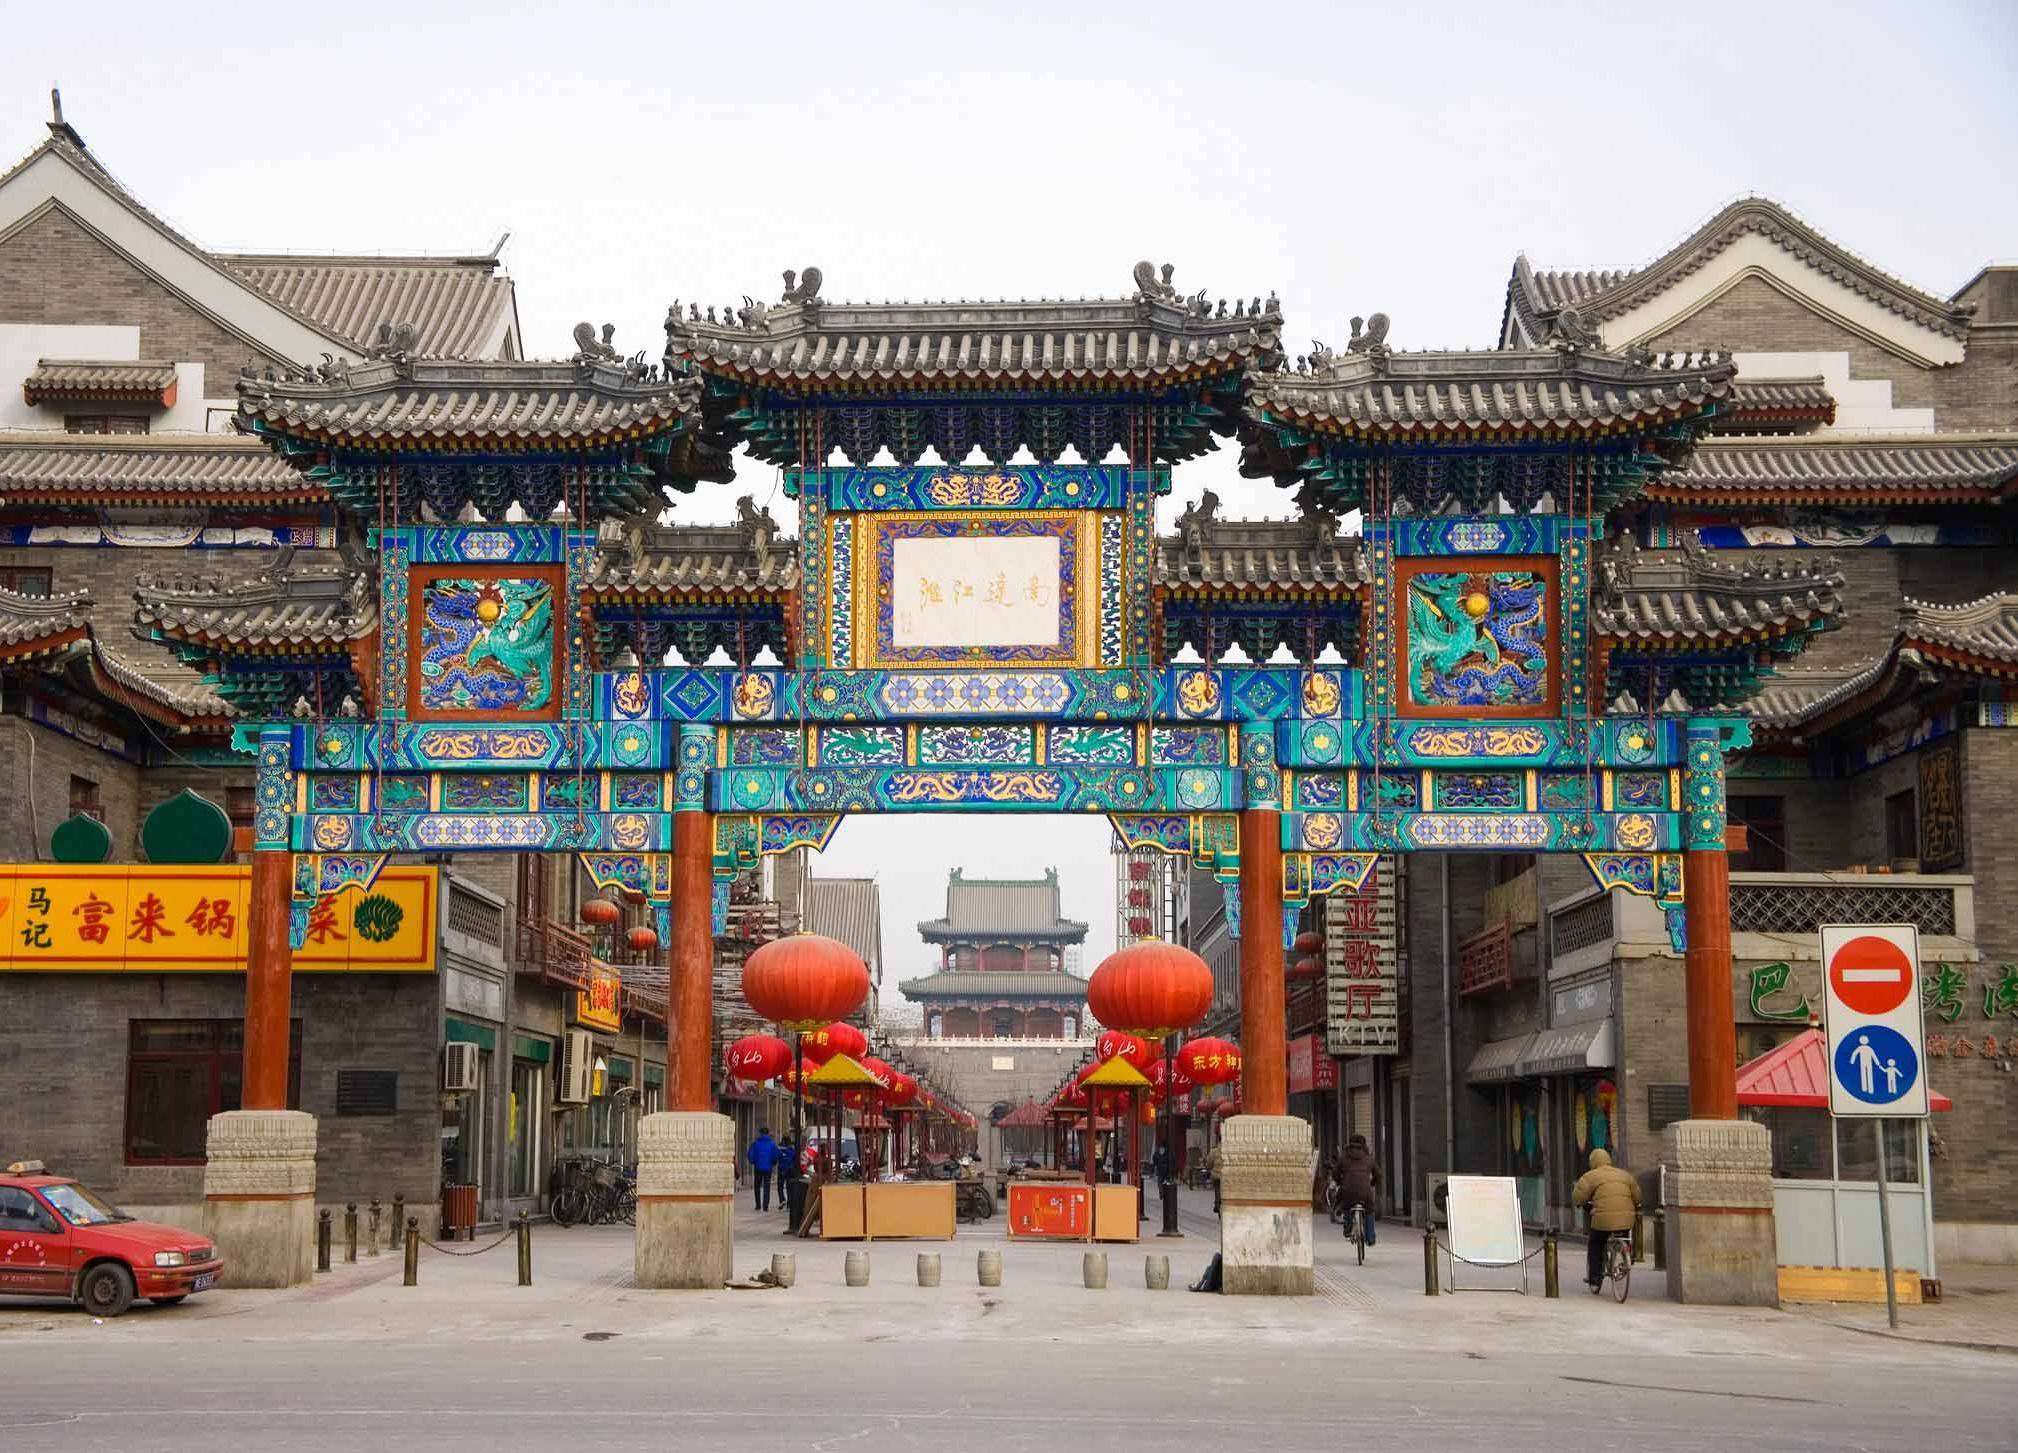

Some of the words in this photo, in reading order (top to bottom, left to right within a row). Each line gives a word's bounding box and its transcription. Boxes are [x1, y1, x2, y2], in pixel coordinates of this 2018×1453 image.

[20, 887, 53, 949] 马记
[72, 892, 348, 945] 富来锅菜
